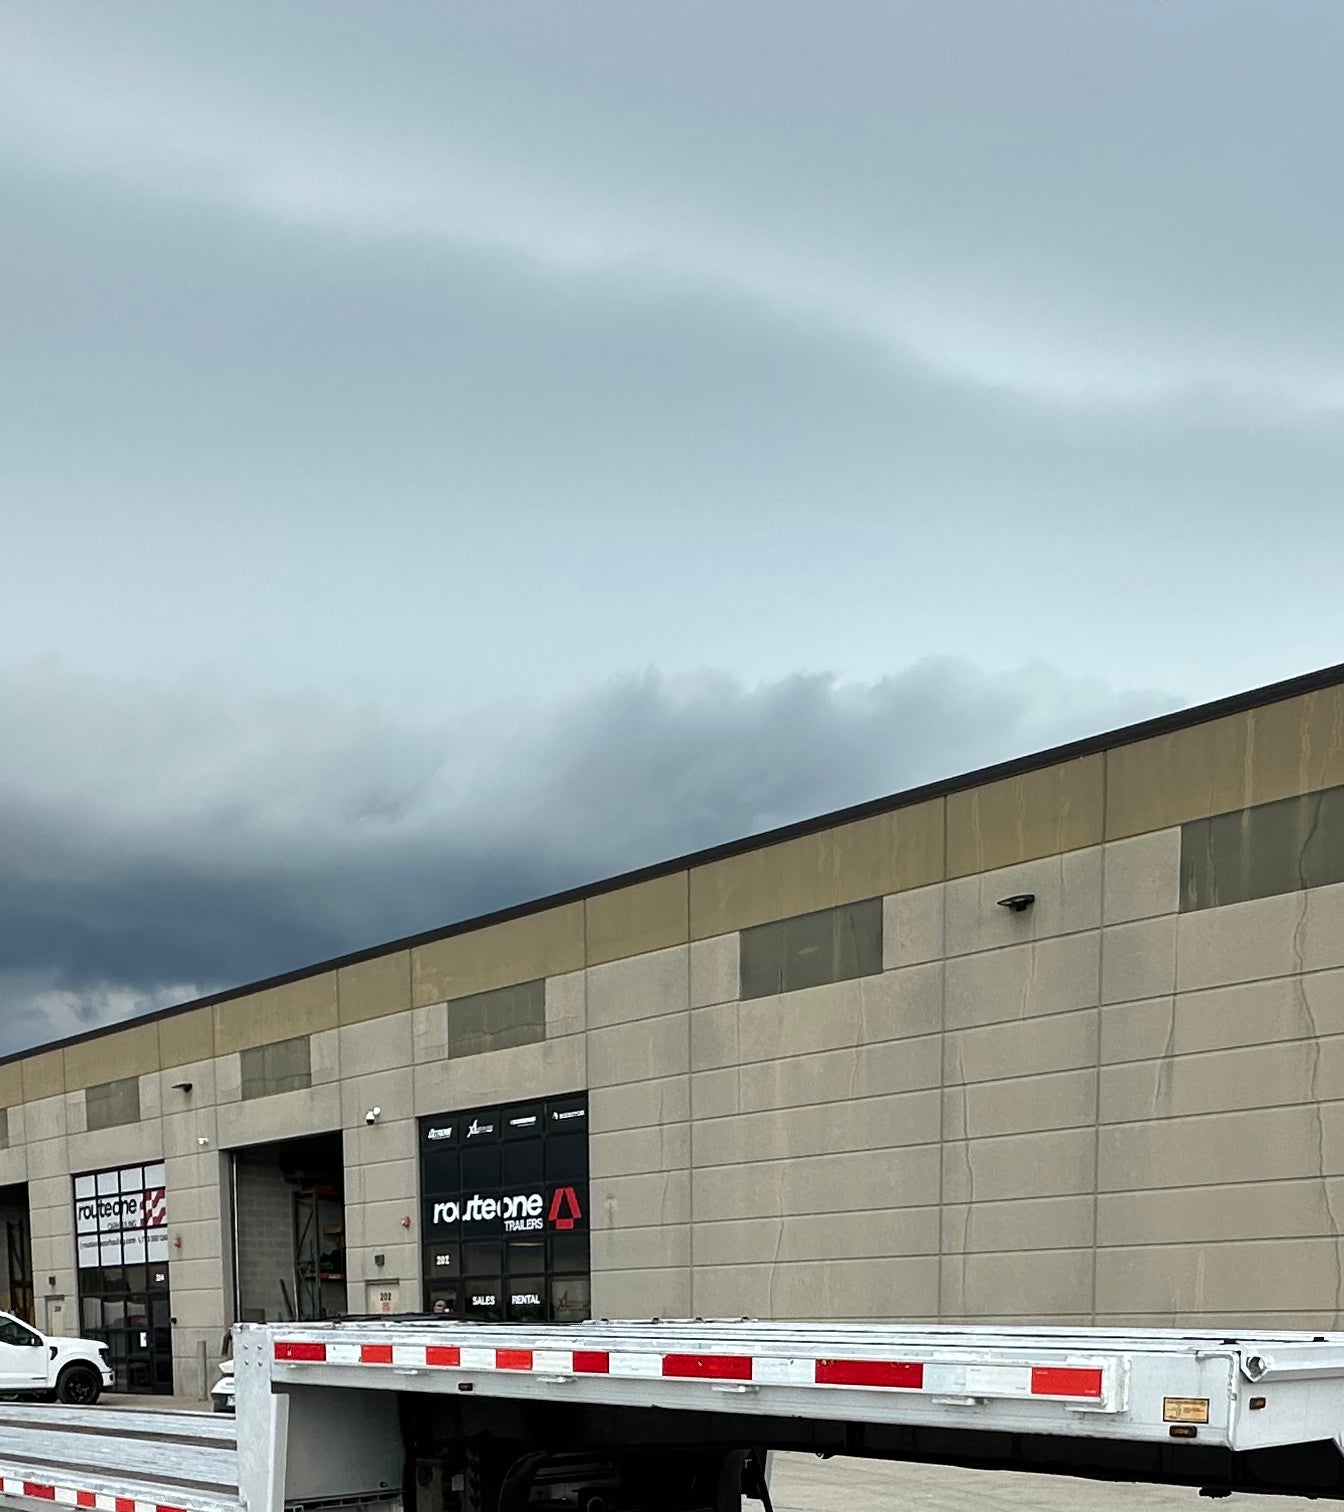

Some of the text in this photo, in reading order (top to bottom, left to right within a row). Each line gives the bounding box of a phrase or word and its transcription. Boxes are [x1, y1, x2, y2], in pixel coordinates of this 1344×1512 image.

[78, 1198, 137, 1221] routeone
[433, 1193, 544, 1224] routeone
[504, 1217, 544, 1232] TRAILERS
[472, 1294, 541, 1306] SALES RENTAL
